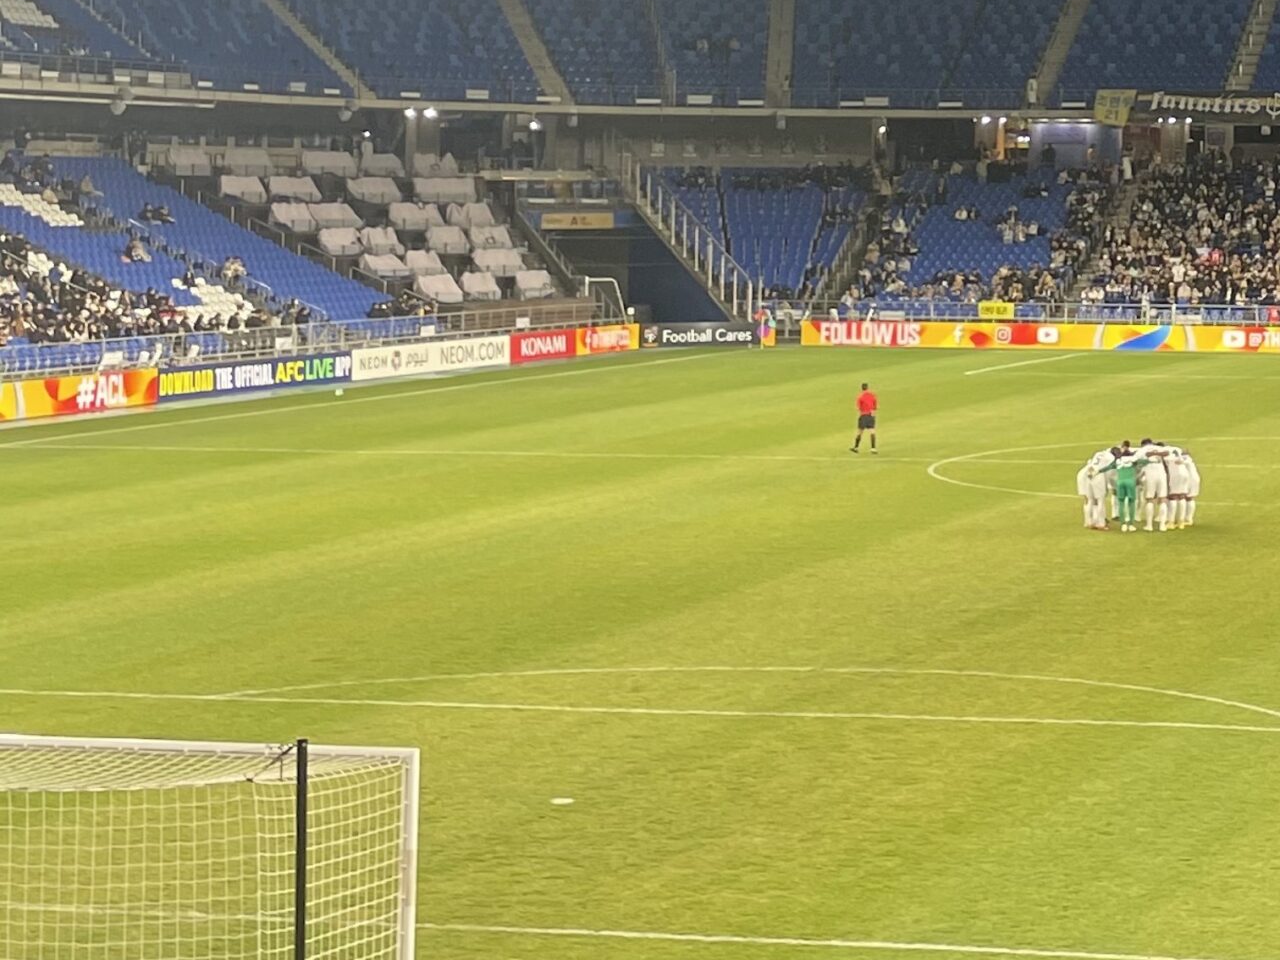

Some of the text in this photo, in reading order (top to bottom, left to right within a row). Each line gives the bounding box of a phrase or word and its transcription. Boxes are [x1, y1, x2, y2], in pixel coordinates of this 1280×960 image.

[662, 327, 752, 344] Football Cares
[820, 322, 921, 345] FOLLOW US
[440, 341, 505, 365] NEOM.COM
[521, 334, 567, 357] KONAMI
[359, 356, 388, 371] NEOM
[159, 369, 214, 397] DOWNLOAD
[215, 367, 233, 390] THE
[234, 363, 274, 389] OFFICIAL
[275, 360, 305, 384] AFC
[305, 357, 334, 381] LIVE
[76, 373, 127, 410] #ACL
